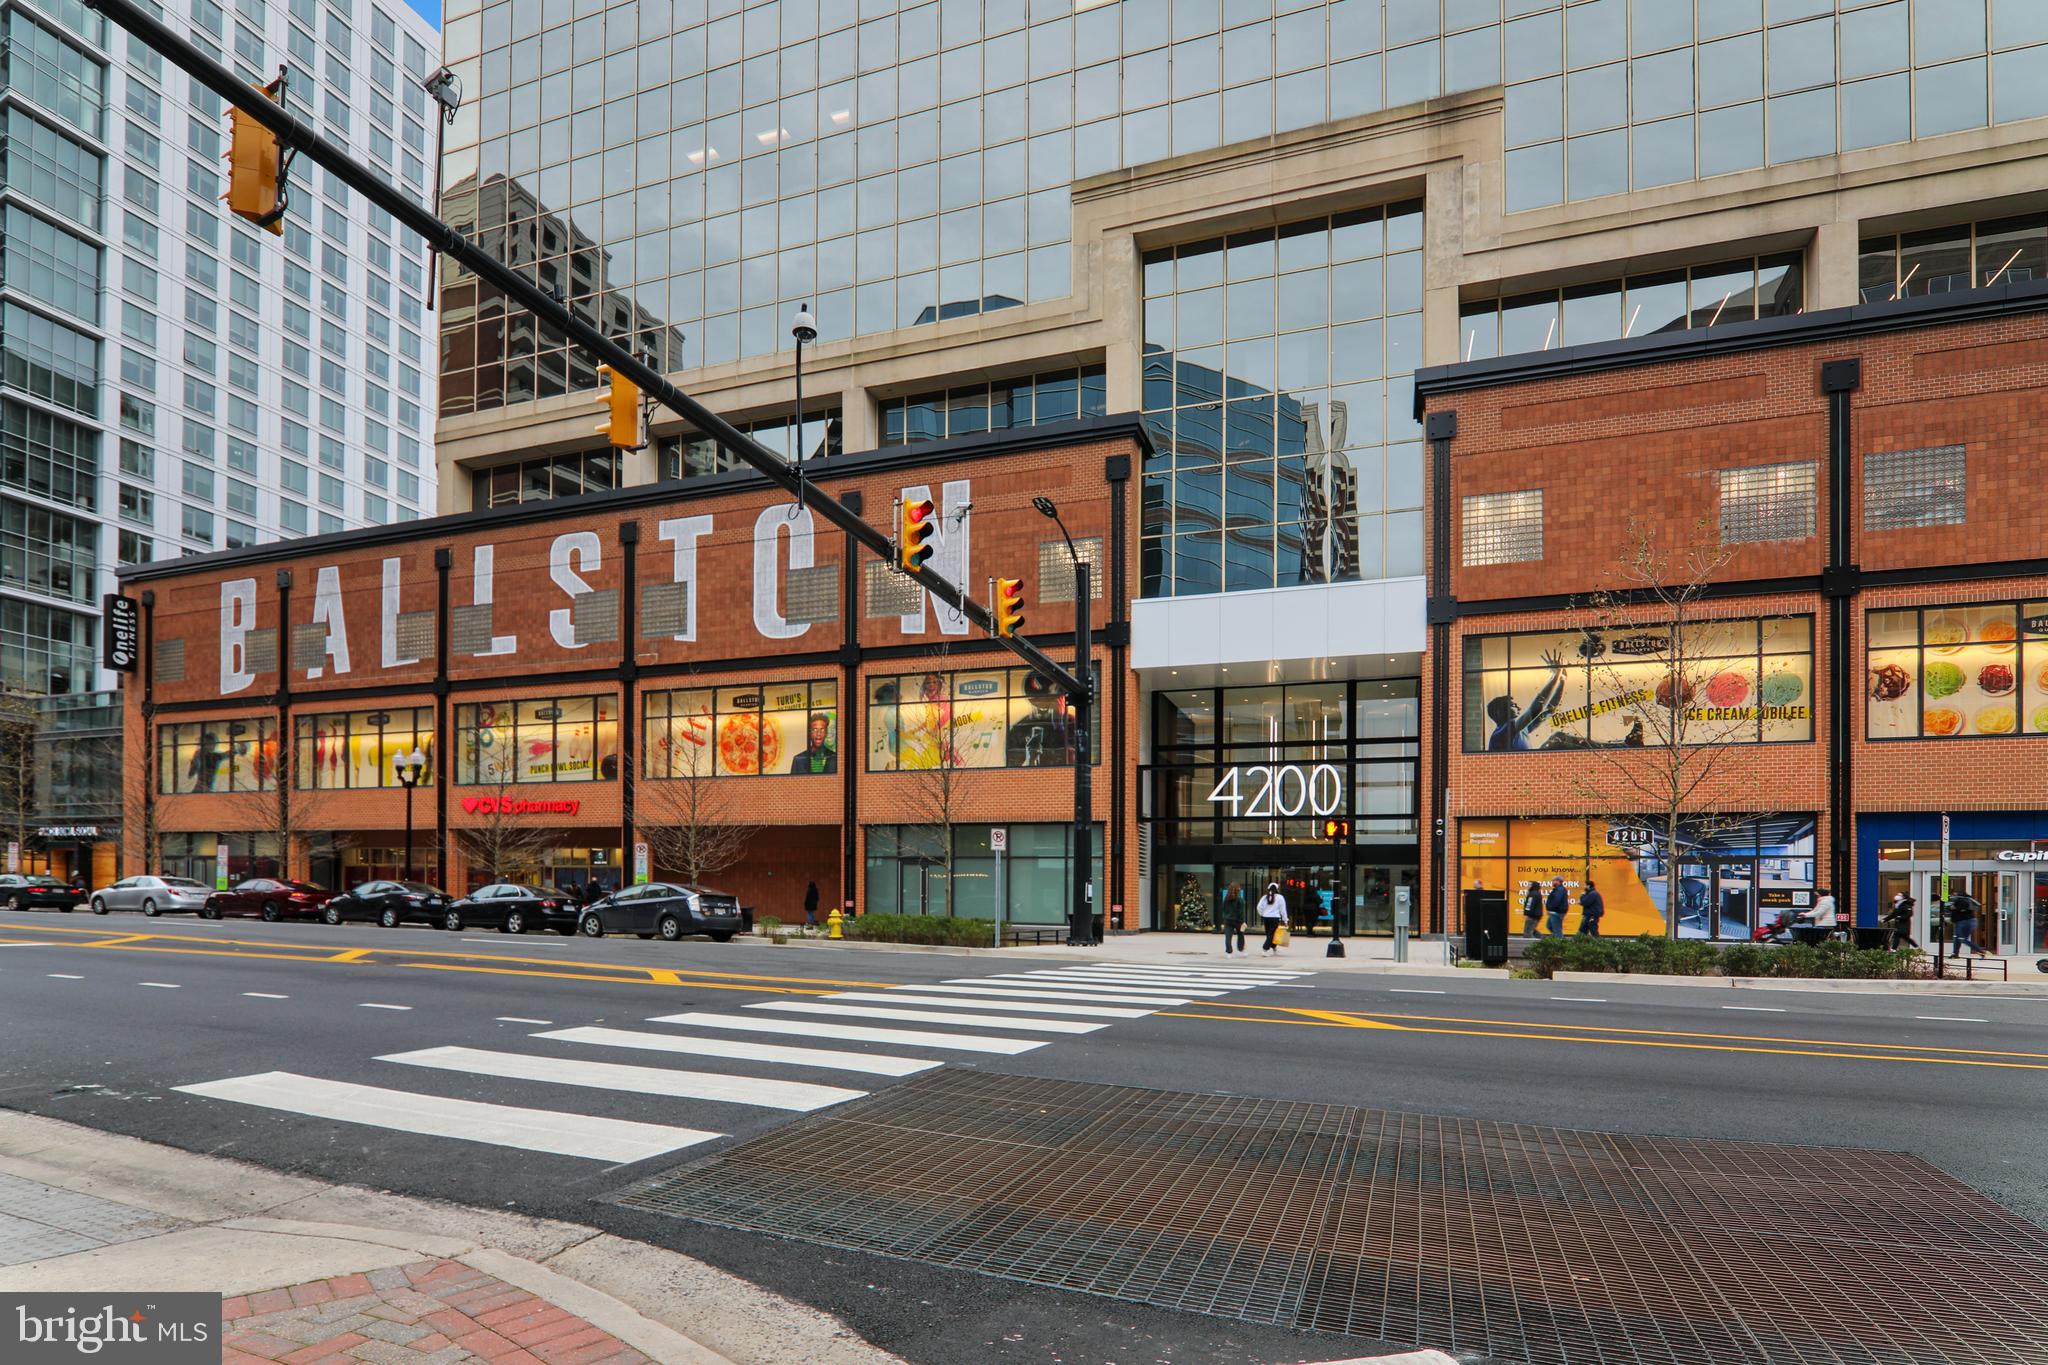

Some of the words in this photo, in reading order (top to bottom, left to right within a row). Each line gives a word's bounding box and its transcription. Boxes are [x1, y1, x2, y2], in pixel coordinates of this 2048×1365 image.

[220, 480, 970, 694] BALLSTON
[128, 611, 136, 659] FITNESS
[776, 693, 801, 706] TURU'S
[1599, 689, 1647, 713] FITNESS
[1707, 707, 1749, 720] CREAM
[1207, 764, 1342, 817] 4200
[513, 799, 580, 816] pharmacy
